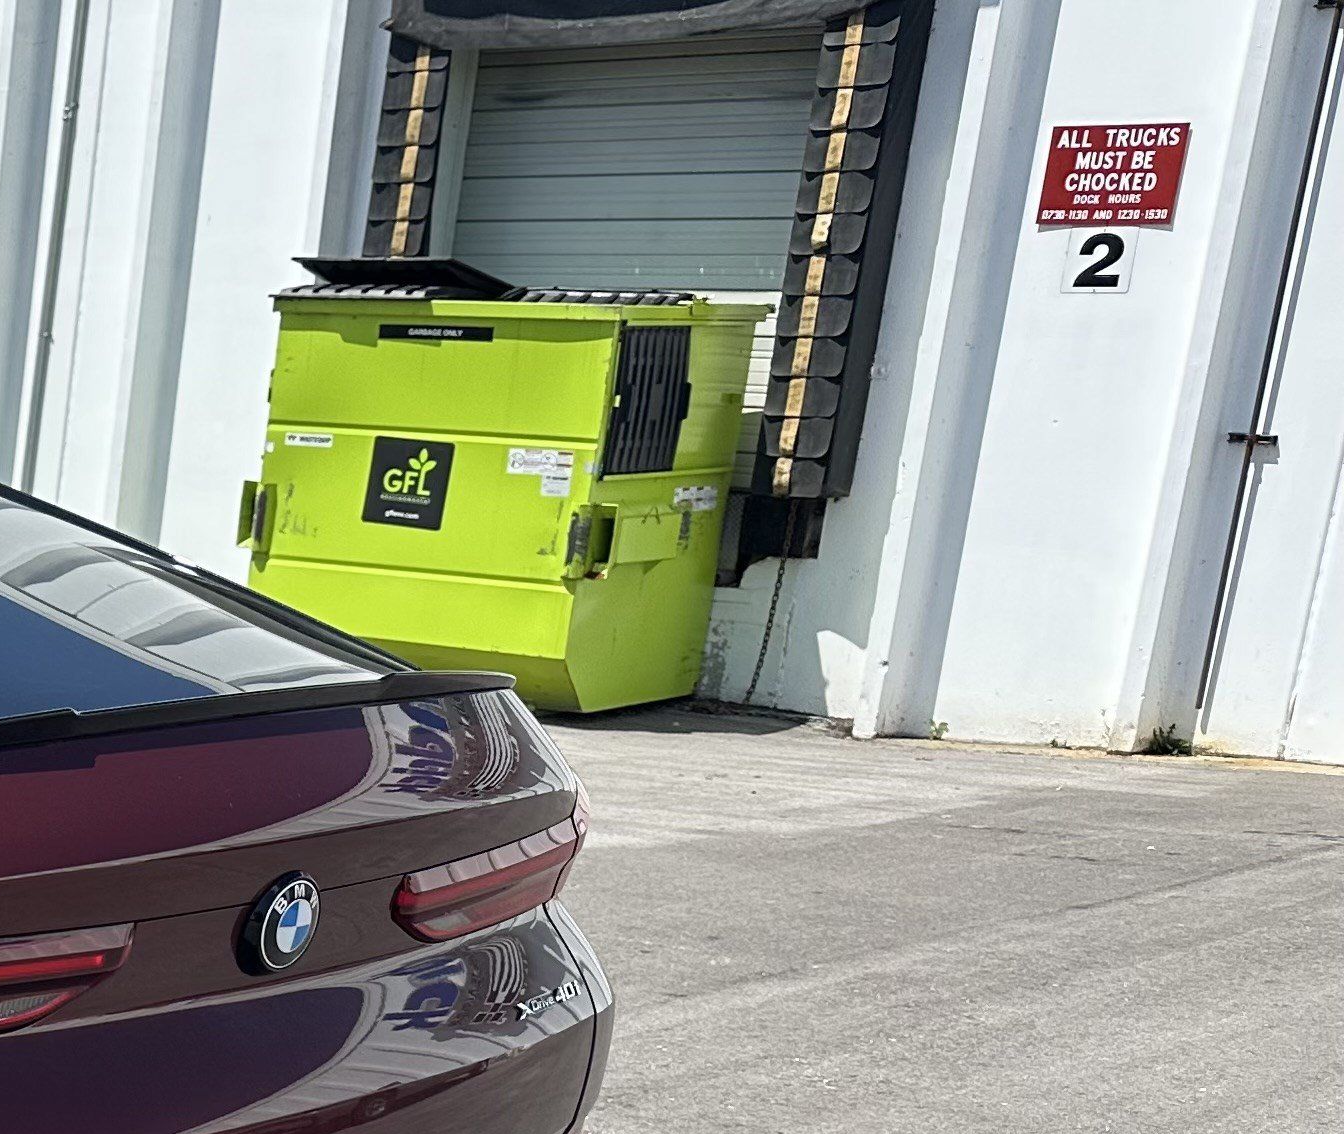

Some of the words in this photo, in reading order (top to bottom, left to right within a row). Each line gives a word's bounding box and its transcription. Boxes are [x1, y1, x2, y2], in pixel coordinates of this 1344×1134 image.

[1056, 129, 1092, 149] ALL
[1106, 127, 1181, 148] TRUCKS
[1075, 151, 1127, 170] MUST
[1131, 150, 1156, 169] BE
[1065, 173, 1157, 192] CHOCKED
[1073, 194, 1100, 205] DOCK
[1108, 193, 1142, 204] HOURS
[1093, 209, 1112, 220] AND
[1072, 232, 1125, 288] 2
[383, 460, 437, 496] GFL
[274, 883, 319, 915] BMW
